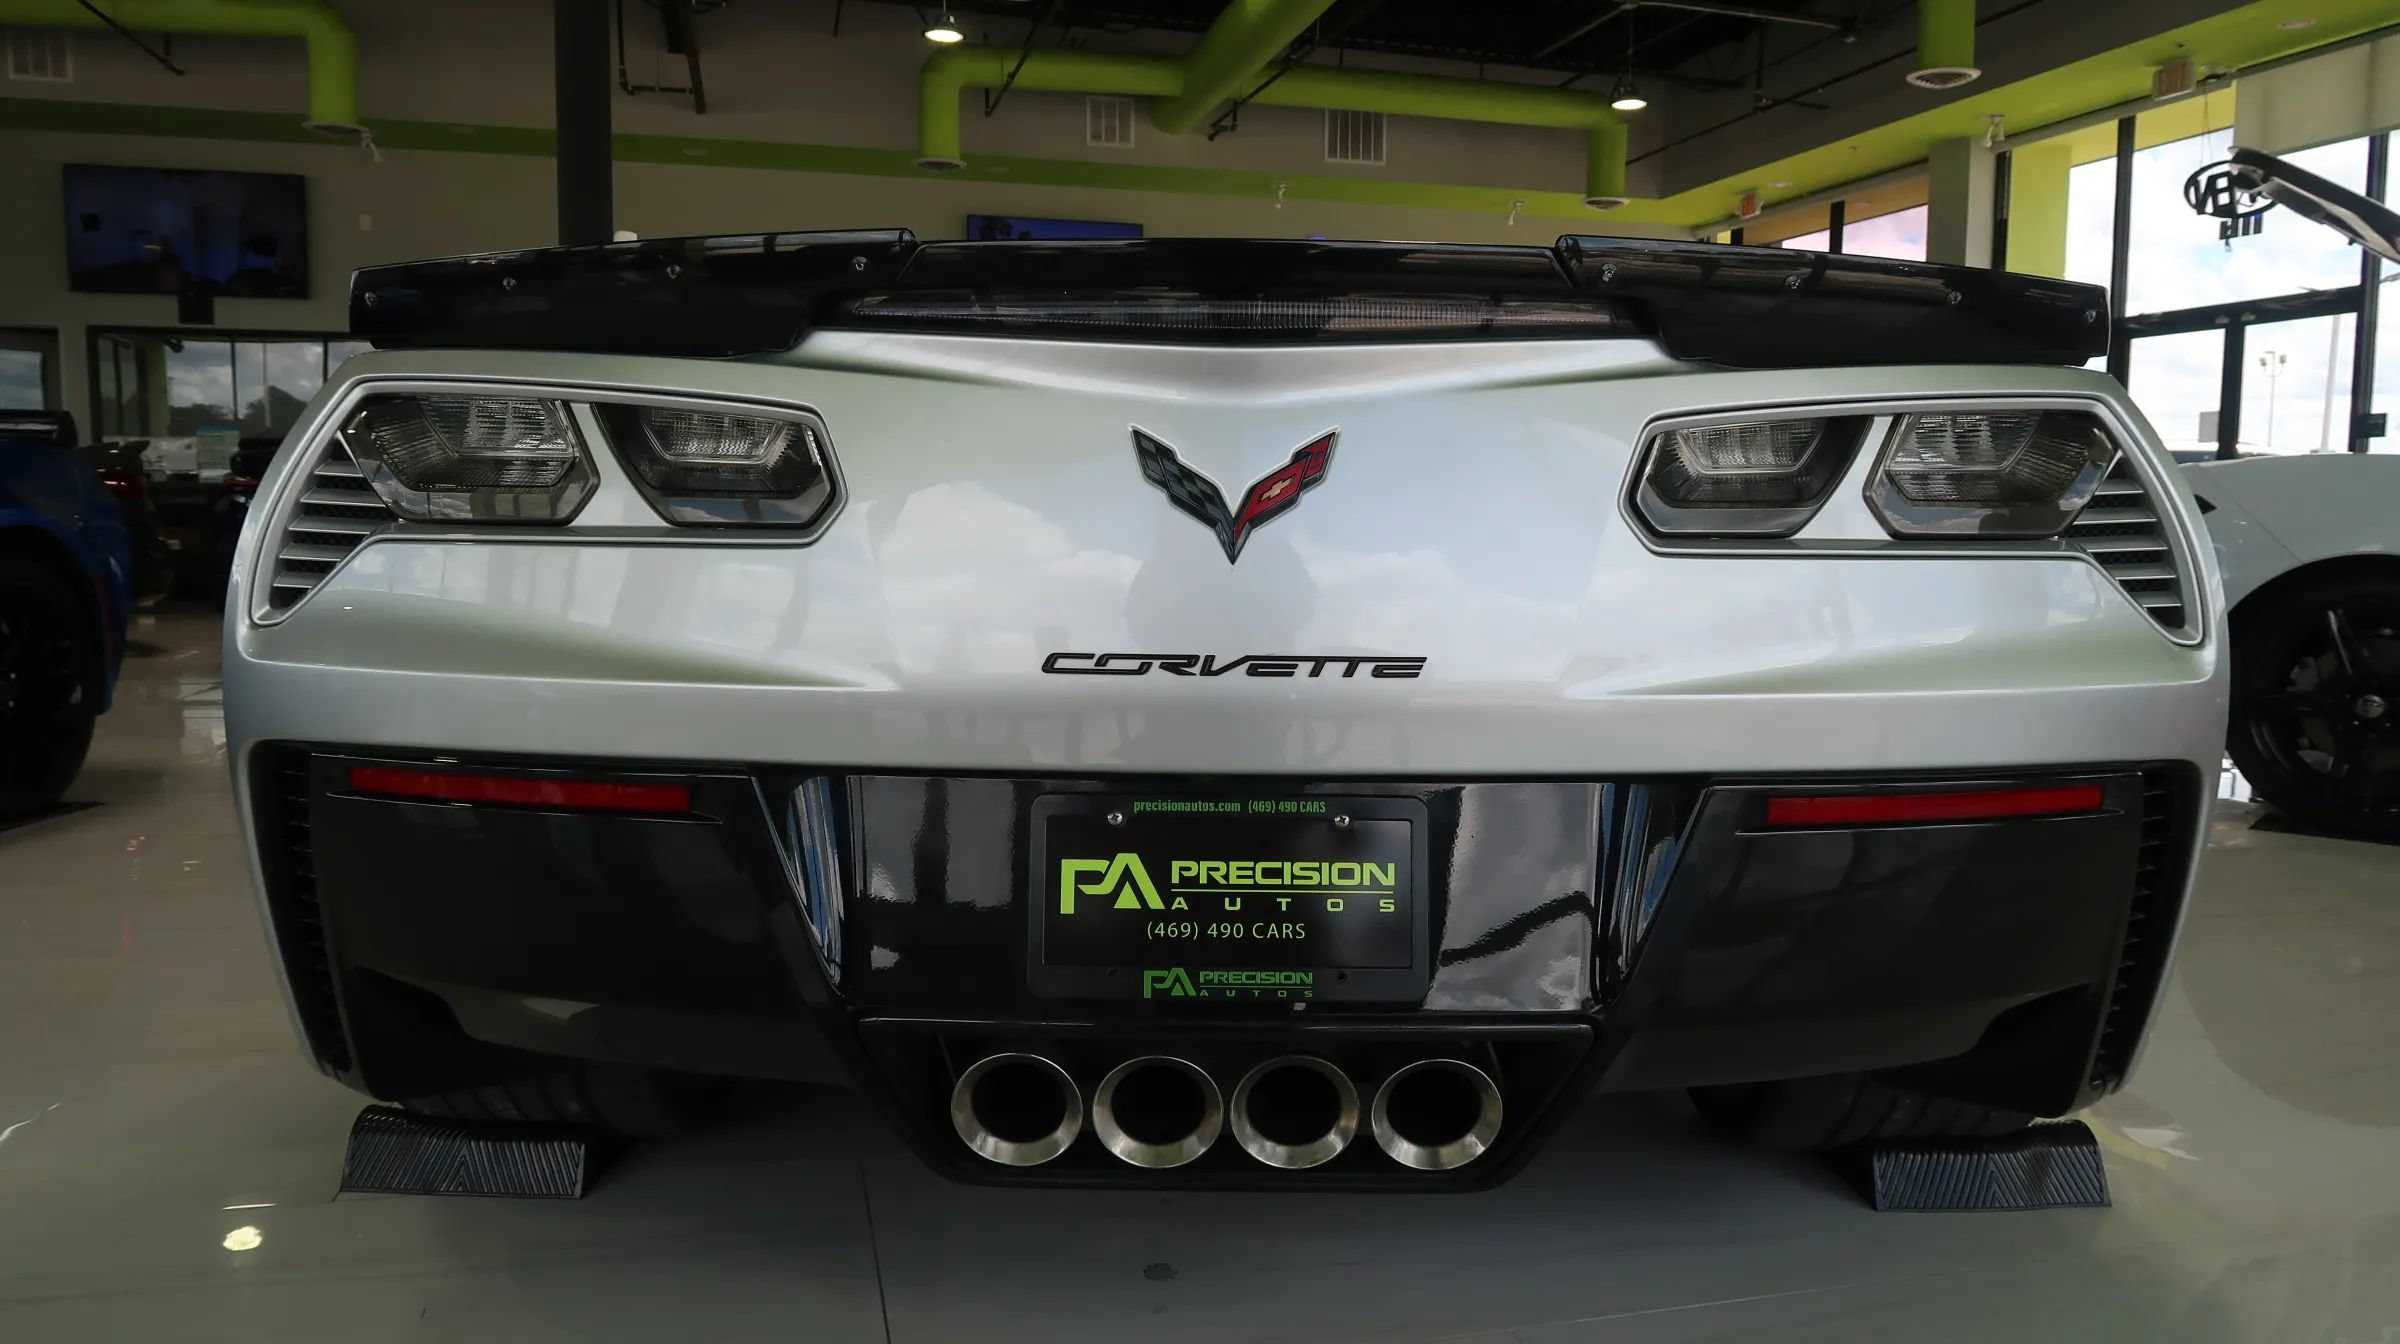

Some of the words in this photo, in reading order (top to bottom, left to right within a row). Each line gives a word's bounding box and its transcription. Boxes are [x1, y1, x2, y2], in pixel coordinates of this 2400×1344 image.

[1041, 652, 1428, 679] CORVETTE
[1133, 799, 1241, 815] precisionautos.com
[1248, 799, 1276, 815] (469)
[1279, 800, 1298, 813] 490
[1300, 800, 1327, 814] CARS
[1171, 860, 1397, 887] PRECISION
[1171, 896, 1396, 913] AUTOS
[1147, 921, 1199, 941] (469)
[1207, 922, 1244, 940] 490
[1252, 922, 1306, 940] CARS
[1199, 970, 1313, 985] PRECISION
[1199, 989, 1313, 998] AUTOS
